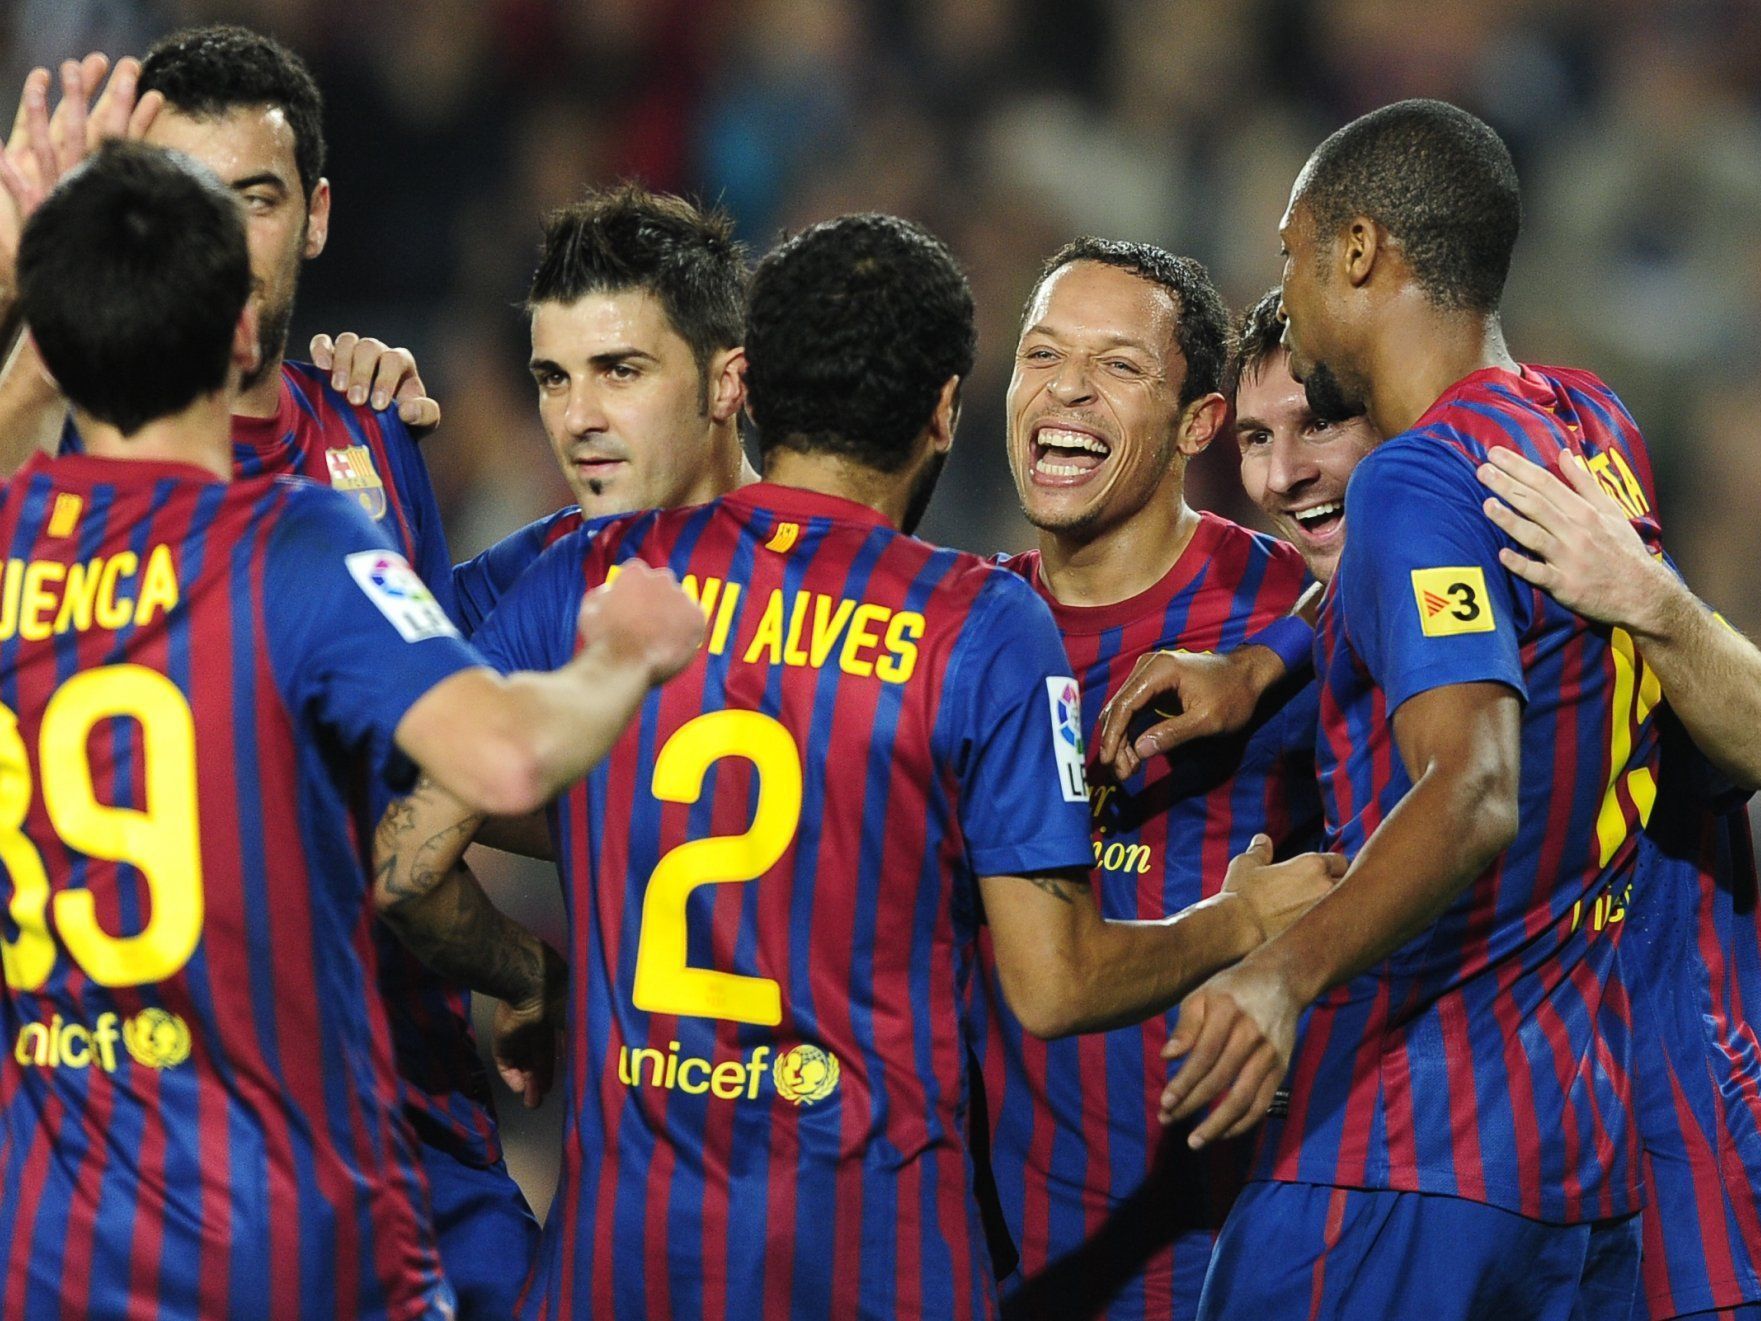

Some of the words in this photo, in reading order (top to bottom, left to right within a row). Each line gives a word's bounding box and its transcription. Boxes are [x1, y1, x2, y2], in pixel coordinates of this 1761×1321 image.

[743, 588, 926, 684] ALVES
[1447, 583, 1479, 622] 3
[633, 708, 802, 1027] 2
[618, 1040, 770, 1100] unicef
